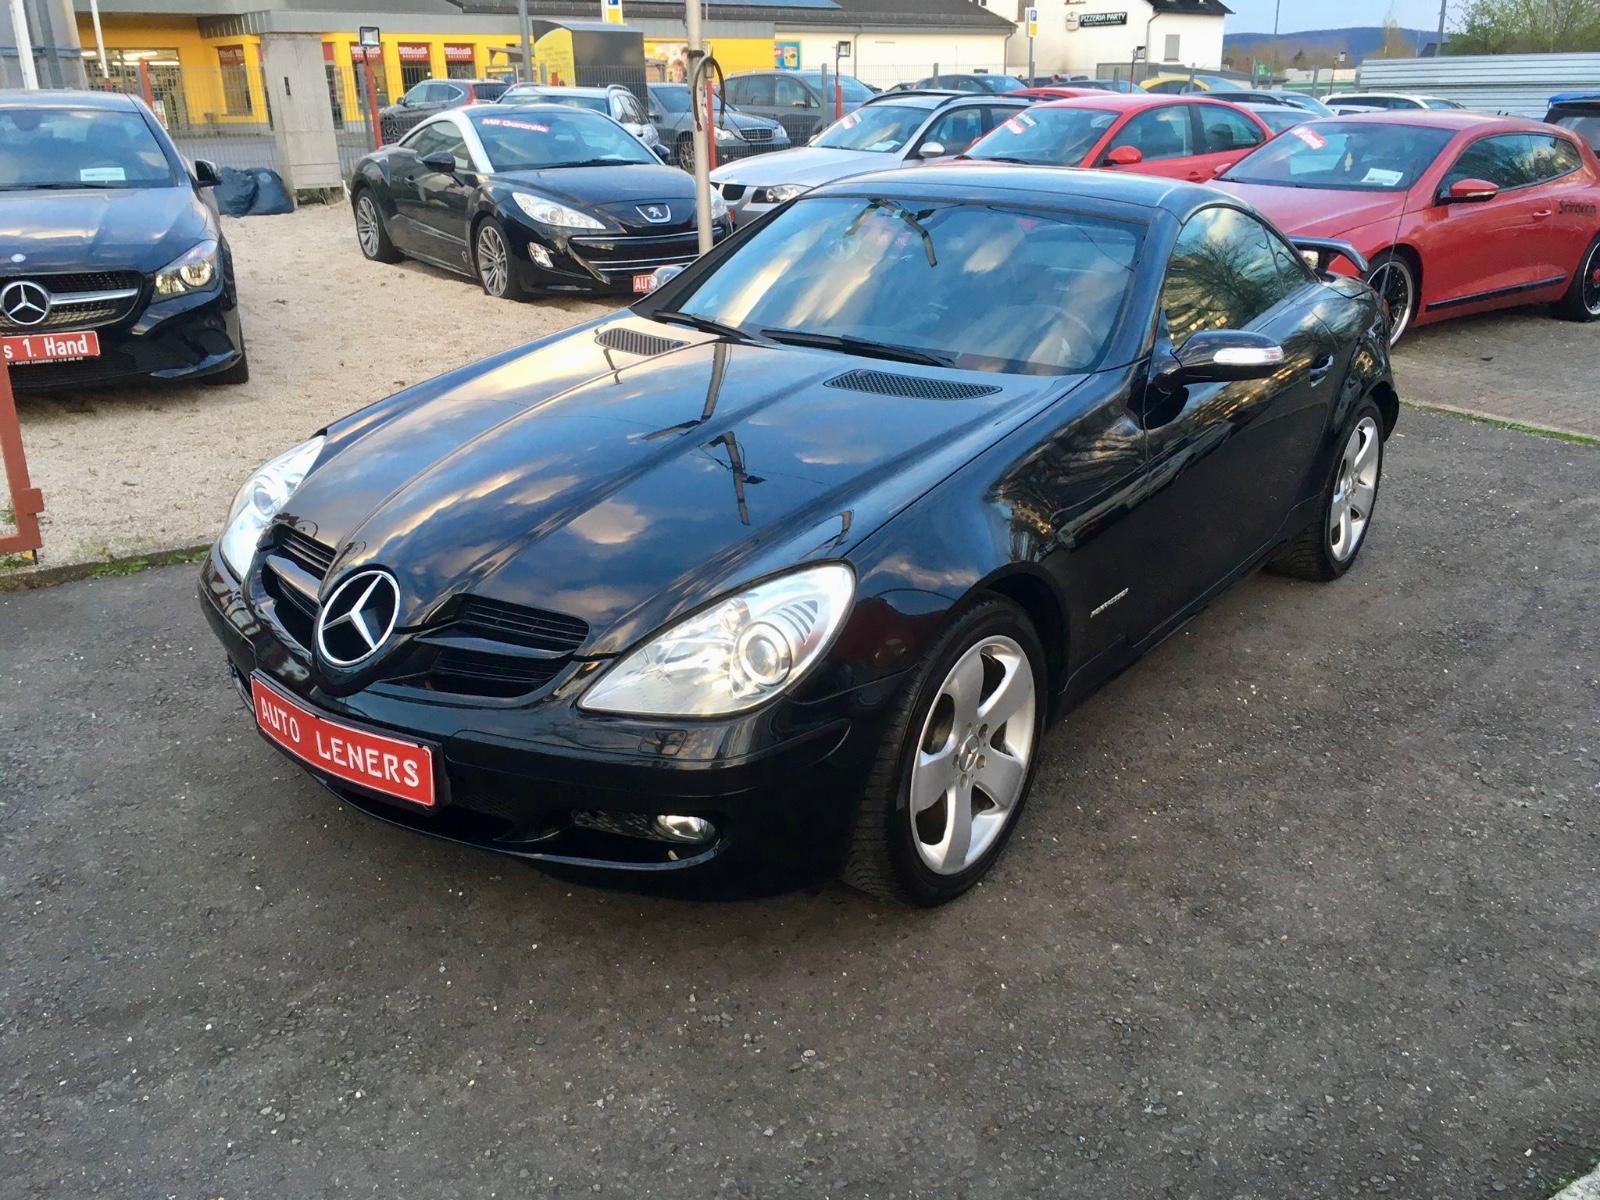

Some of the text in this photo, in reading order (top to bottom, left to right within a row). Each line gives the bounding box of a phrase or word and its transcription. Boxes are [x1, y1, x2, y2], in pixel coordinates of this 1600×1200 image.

[1080, 14, 1106, 23] PIZZERIA
[1106, 12, 1126, 21] PARTY
[22, 338, 37, 358] 1.
[43, 334, 89, 357] Hand
[260, 696, 420, 788] AUTO LENERS
